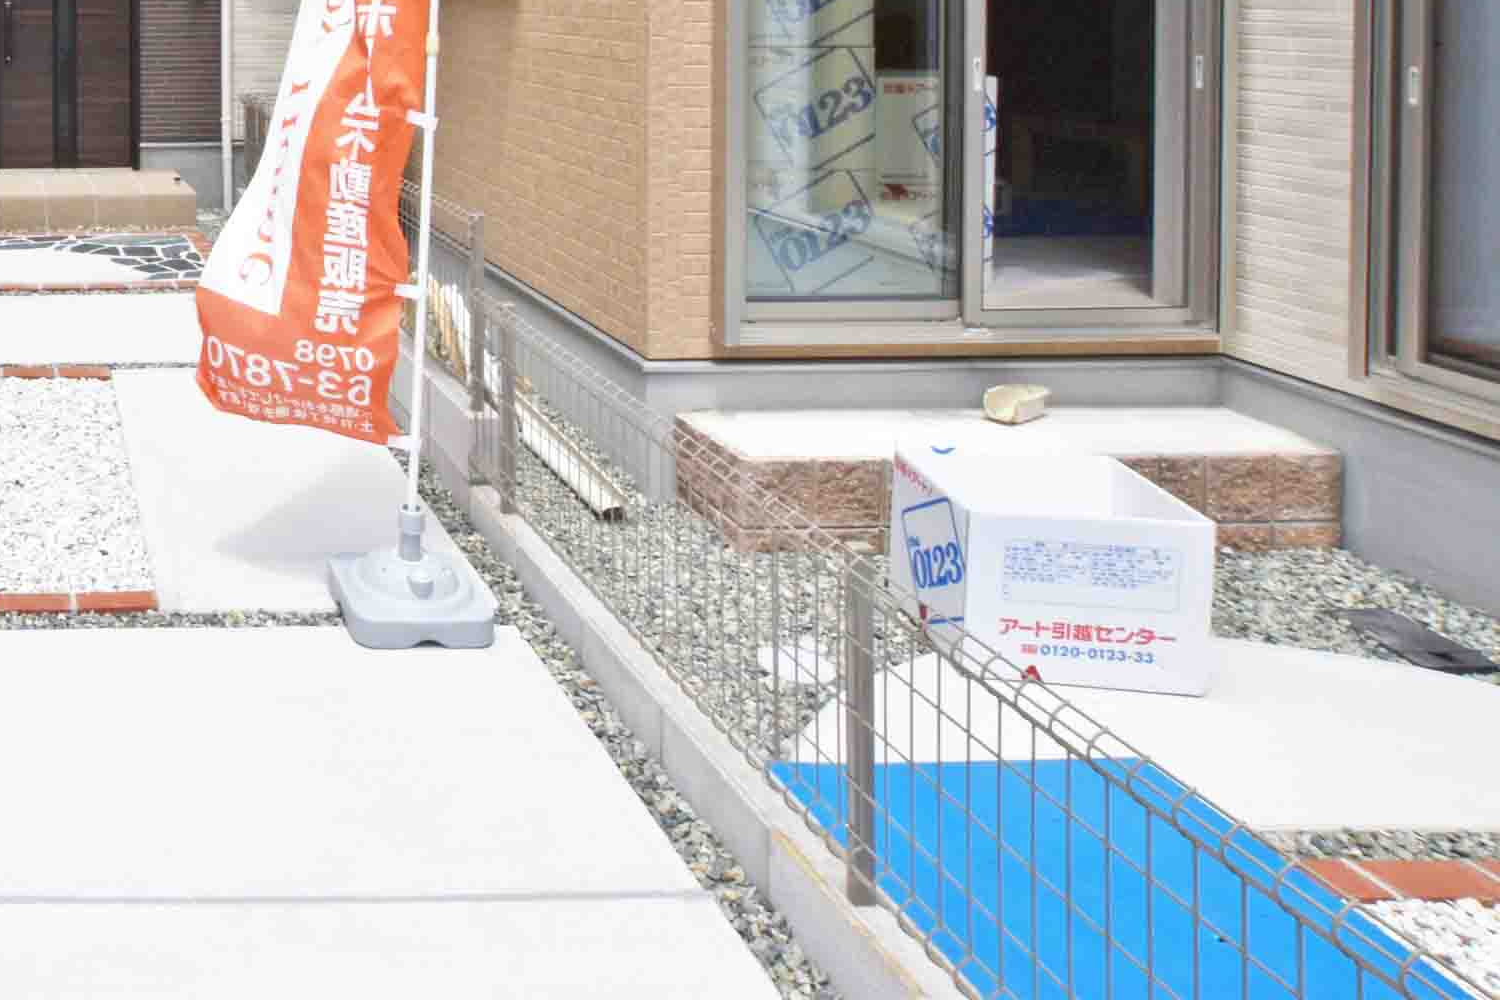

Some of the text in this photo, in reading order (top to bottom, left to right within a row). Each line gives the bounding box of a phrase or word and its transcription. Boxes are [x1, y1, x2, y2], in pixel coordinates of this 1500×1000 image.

[913, 542, 962, 589] 0123
[998, 617, 1177, 645] アート引越センター
[1040, 643, 1155, 664] 0120-0123-33
